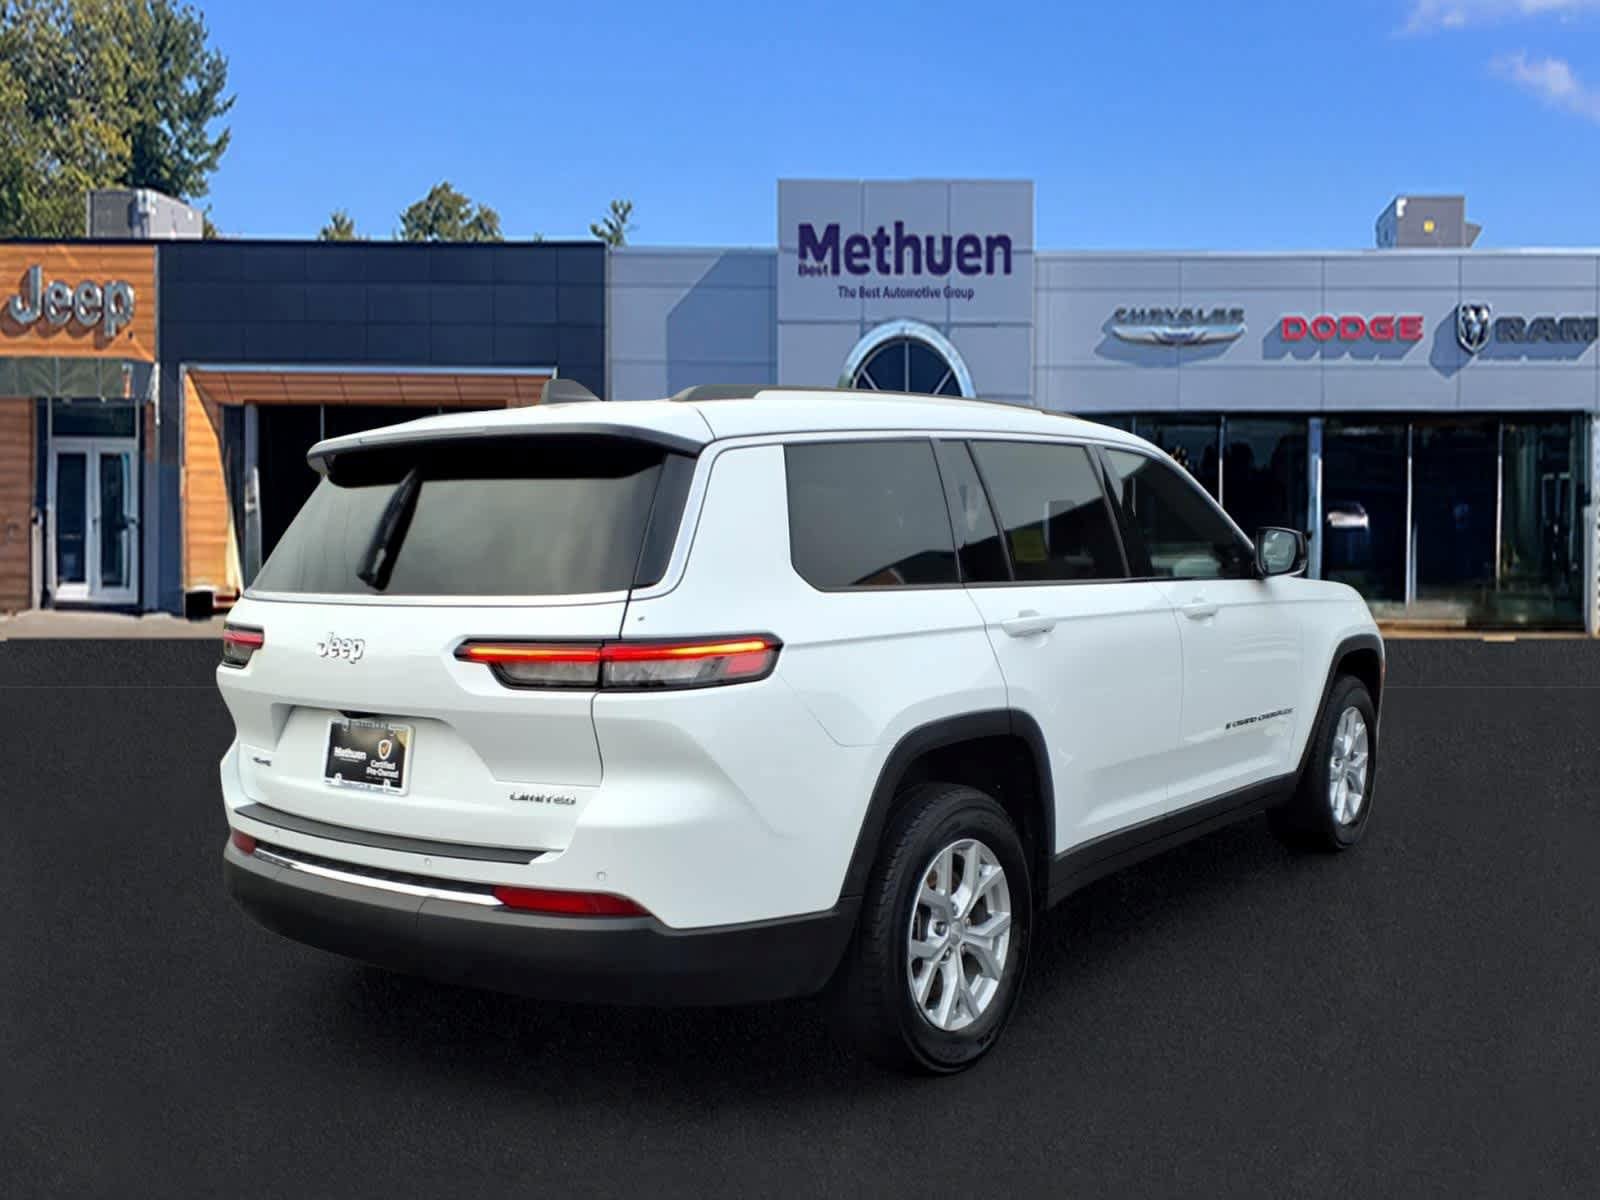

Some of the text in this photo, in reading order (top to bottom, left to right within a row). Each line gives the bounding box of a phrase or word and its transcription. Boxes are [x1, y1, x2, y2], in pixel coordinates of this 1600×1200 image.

[798, 220, 1012, 276] Methuen
[8, 265, 135, 338] Jeep
[838, 285, 975, 301] The Best Automotive Group
[1113, 306, 1245, 324] CHRYSLER
[1281, 315, 1424, 341] DODGE
[1495, 316, 1599, 344] RAM
[317, 631, 366, 664] Jeep
